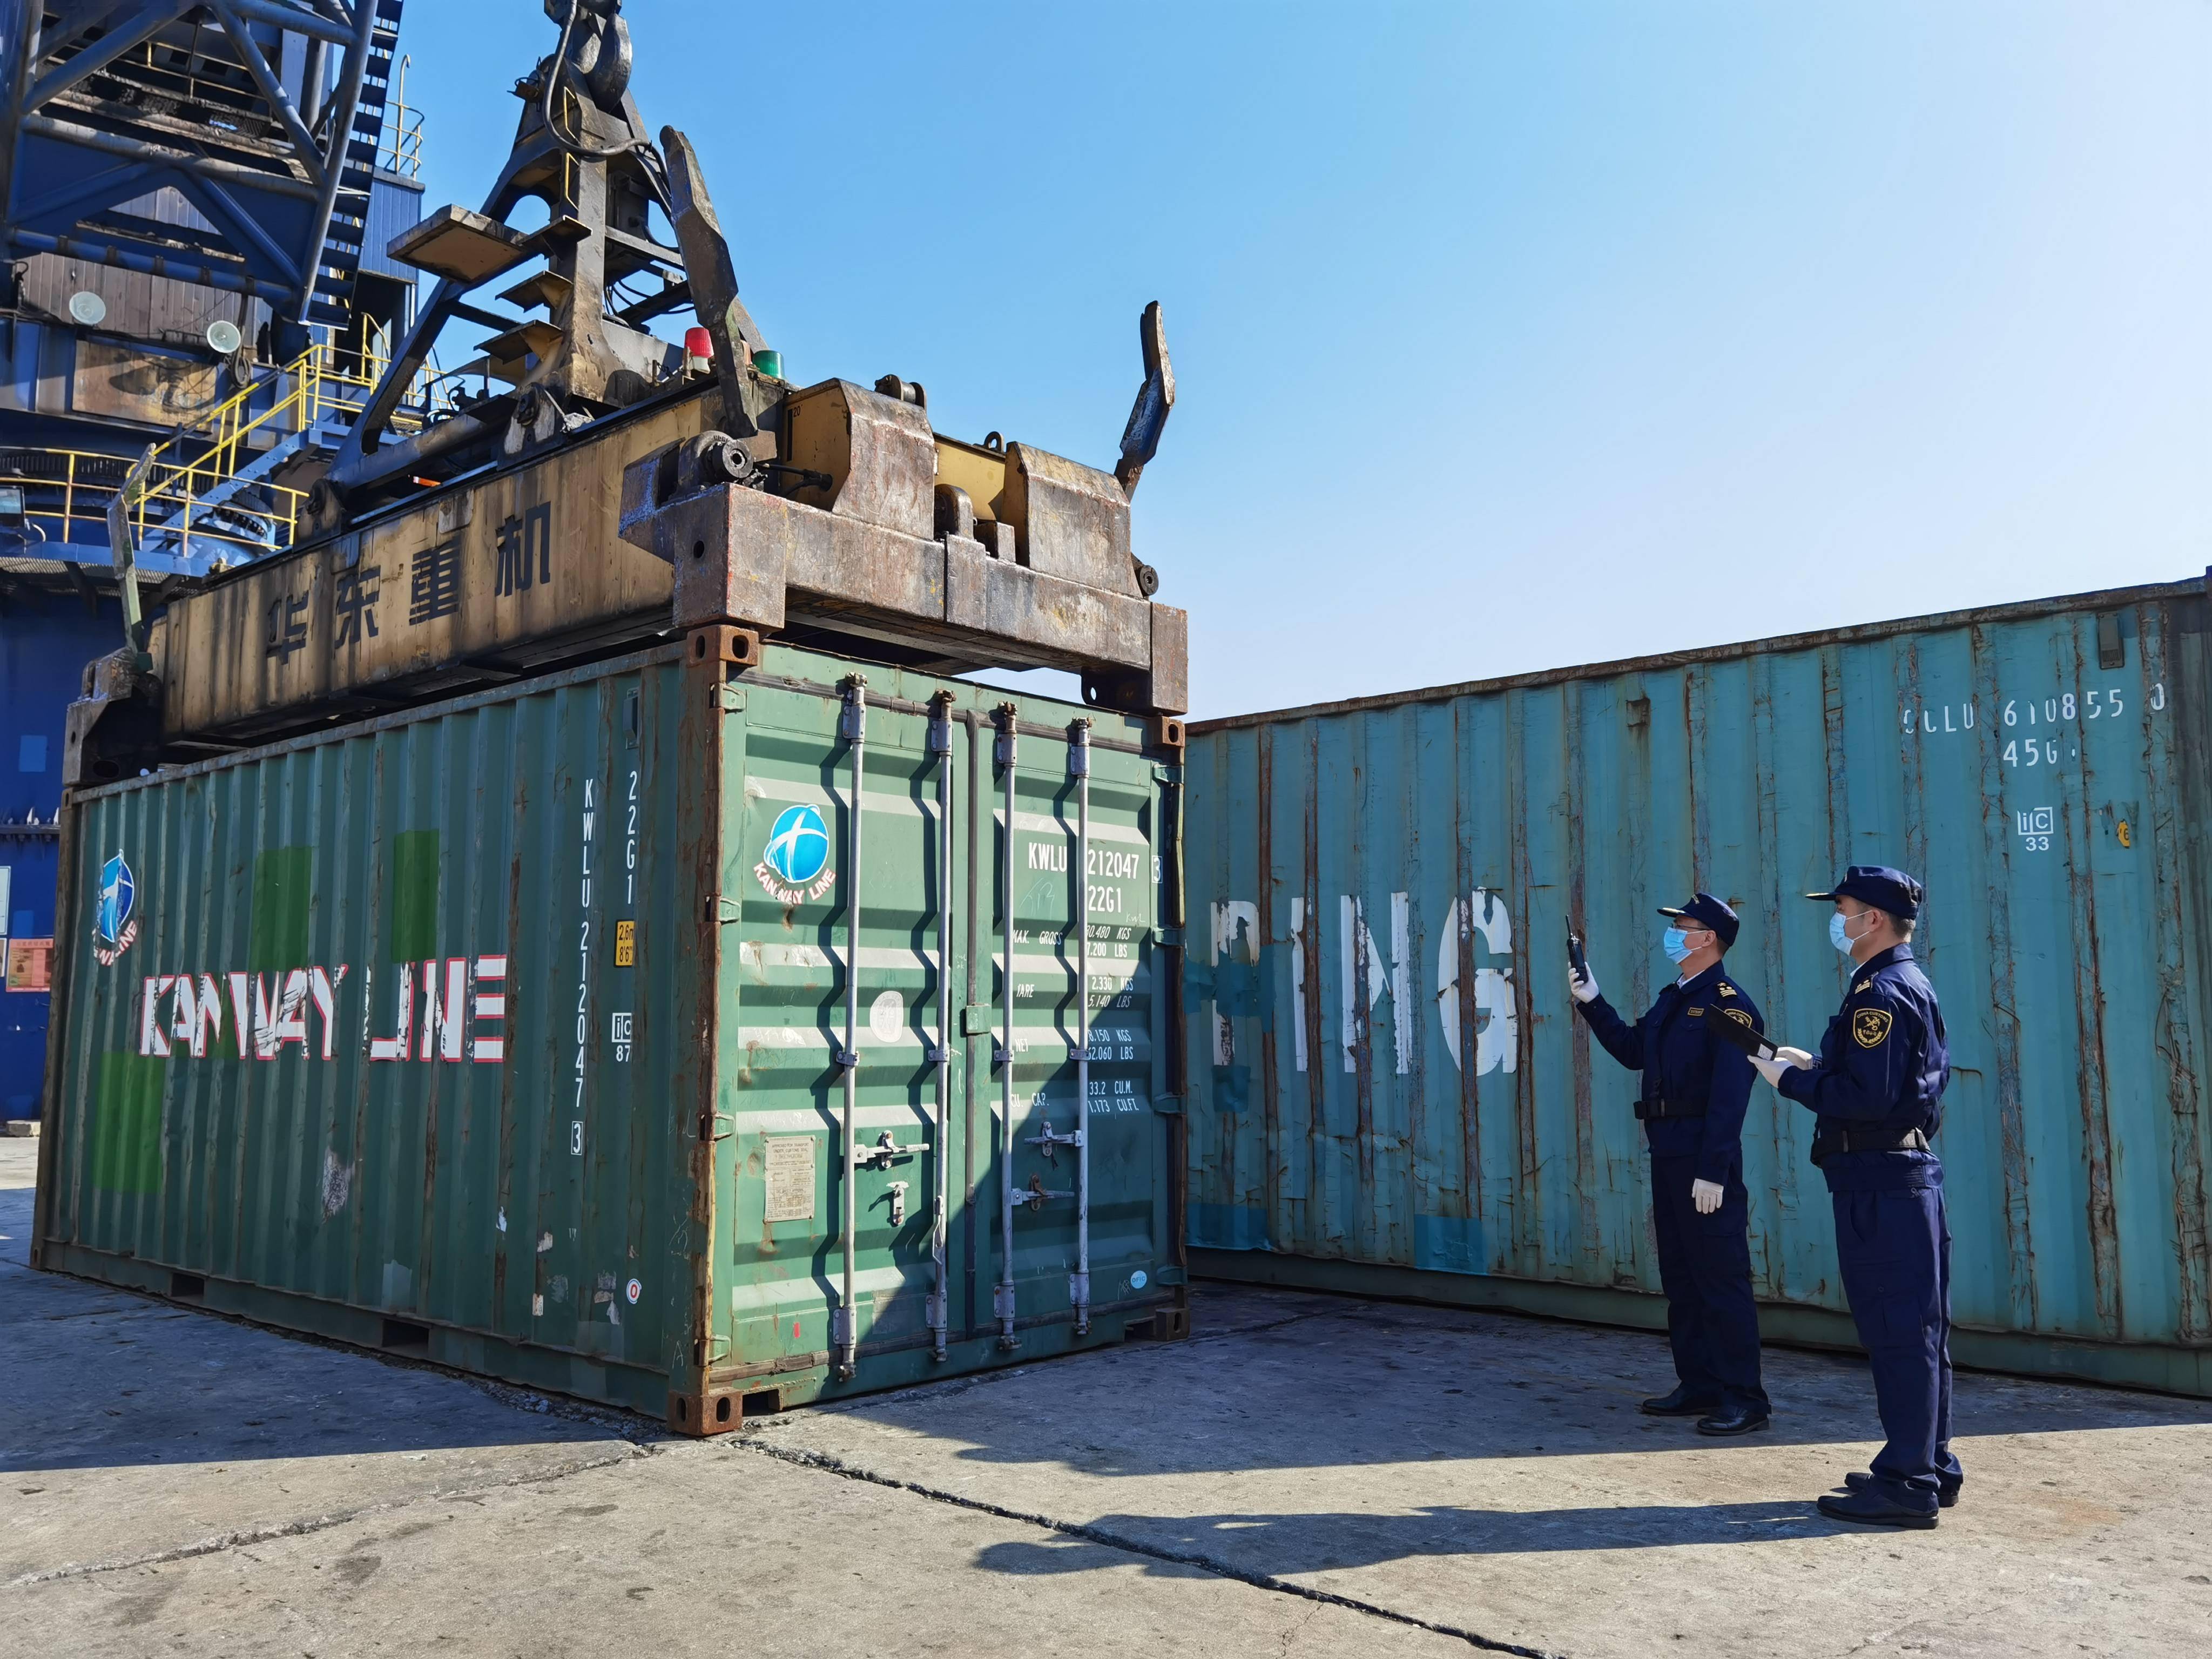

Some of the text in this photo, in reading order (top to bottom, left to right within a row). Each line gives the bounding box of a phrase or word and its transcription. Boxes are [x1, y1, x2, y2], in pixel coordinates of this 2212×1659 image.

[267, 501, 551, 665] 华东重机
[2004, 689, 2123, 726] 610855
[626, 771, 637, 904] 22G1
[2025, 837, 2049, 852] 33
[1028, 842, 1161, 882] KWLU 212047 3
[753, 861, 836, 906] KANWAY LINE
[1088, 885, 1121, 913] 22G1
[1039, 931, 1063, 945] GROSS
[1116, 927, 1131, 940] KGS
[1115, 944, 1128, 957] LBS
[572, 778, 594, 1154] KWLU 212047 3
[1092, 976, 1112, 990] 2.330
[1121, 977, 1134, 991] KGS
[139, 954, 507, 1063] KANWAY LINE
[1117, 996, 1131, 1008] LBS
[616, 1044, 631, 1062] 87
[1015, 1038, 1029, 1052] NET
[1116, 1029, 1131, 1042] KGS
[1121, 1047, 1134, 1060] LBS
[1032, 1092, 1049, 1107] CAP.
[1089, 1081, 1105, 1095] 33.2
[1115, 1081, 1133, 1094] CU.M.
